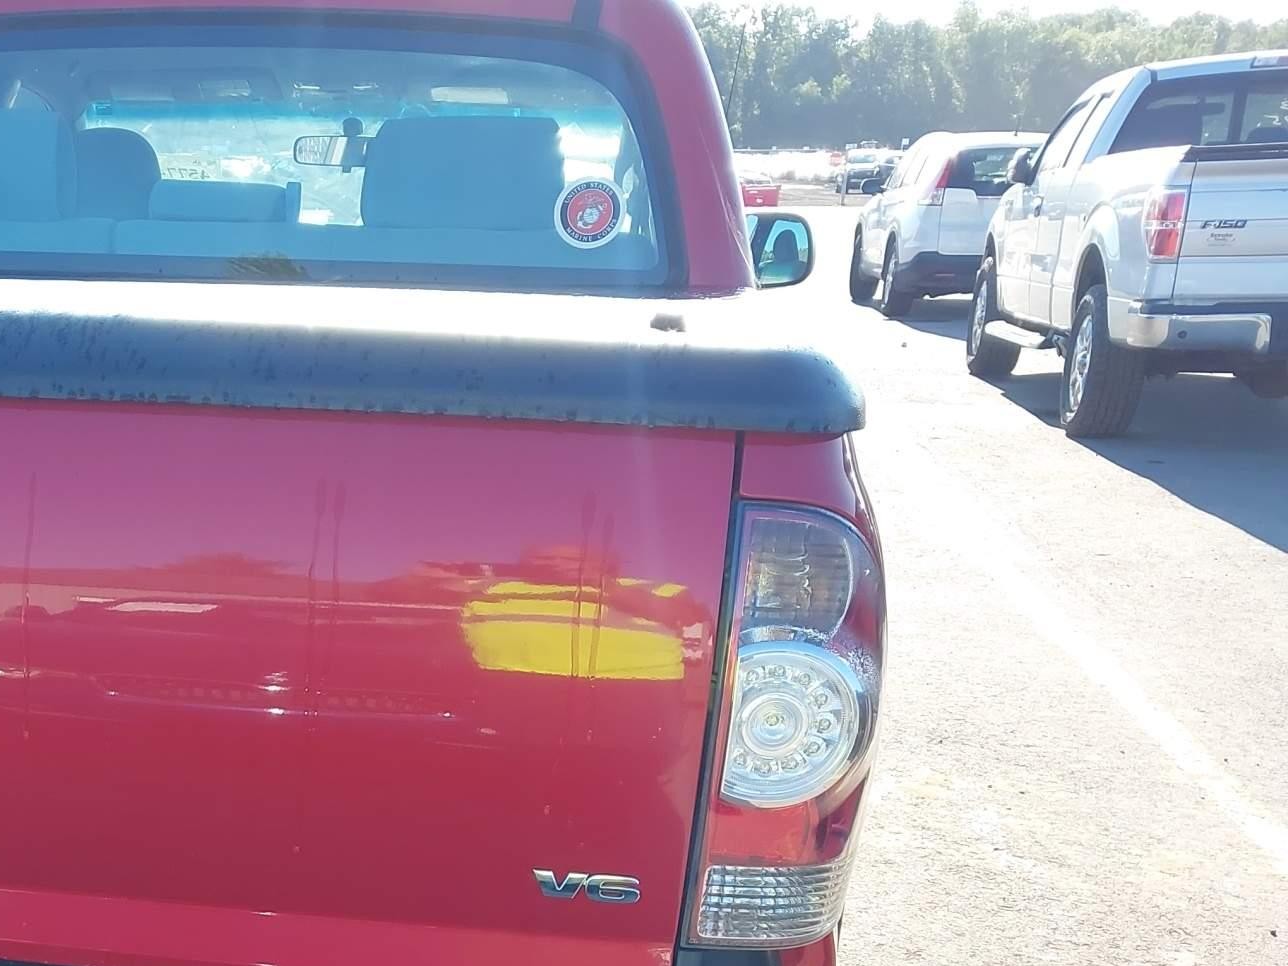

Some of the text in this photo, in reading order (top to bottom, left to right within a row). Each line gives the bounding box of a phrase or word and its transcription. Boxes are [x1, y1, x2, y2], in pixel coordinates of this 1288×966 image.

[565, 182, 614, 204] UNITED STATES
[565, 218, 617, 242] MARINE CORPS
[532, 868, 642, 904] V6
